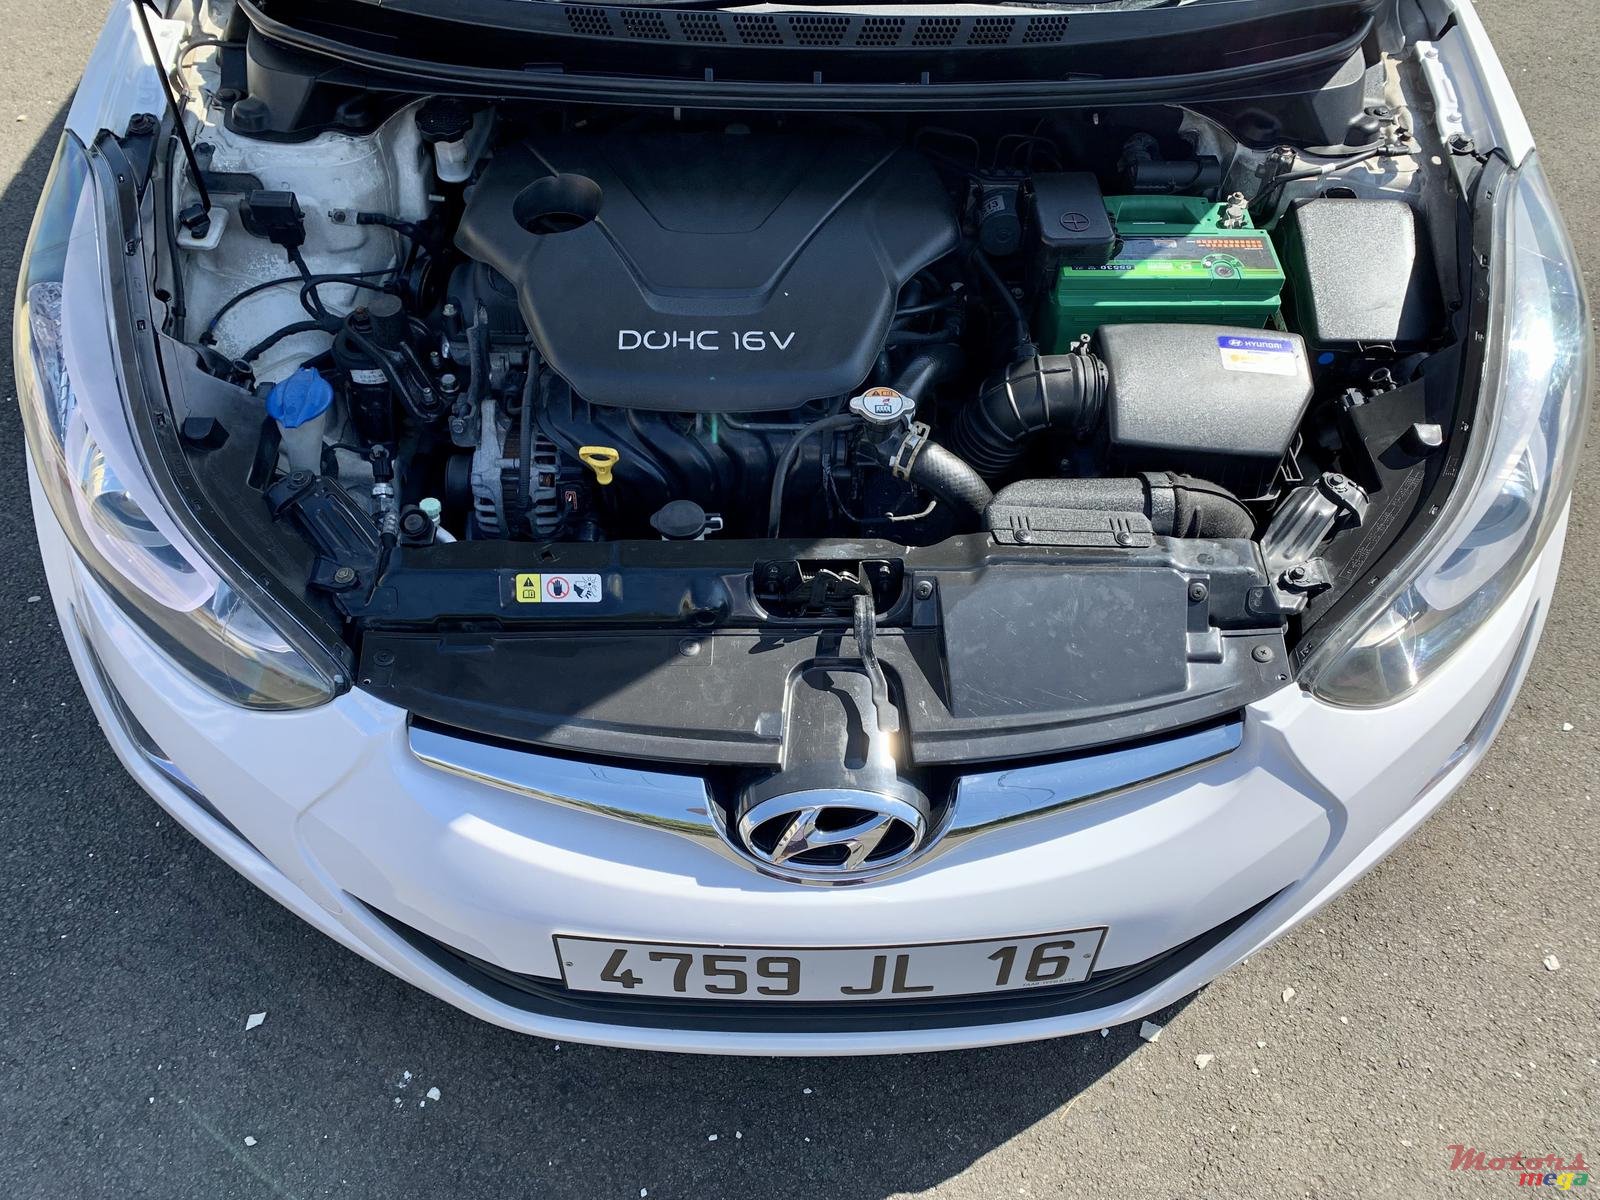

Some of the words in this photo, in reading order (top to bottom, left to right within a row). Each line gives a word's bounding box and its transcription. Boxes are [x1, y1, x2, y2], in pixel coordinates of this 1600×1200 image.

[618, 329, 719, 350] DOHC
[732, 330, 796, 351] 16V
[1244, 340, 1283, 350] HYUNDAI
[600, 949, 801, 996] 4759
[840, 954, 934, 995] JL
[987, 940, 1076, 986] 16
